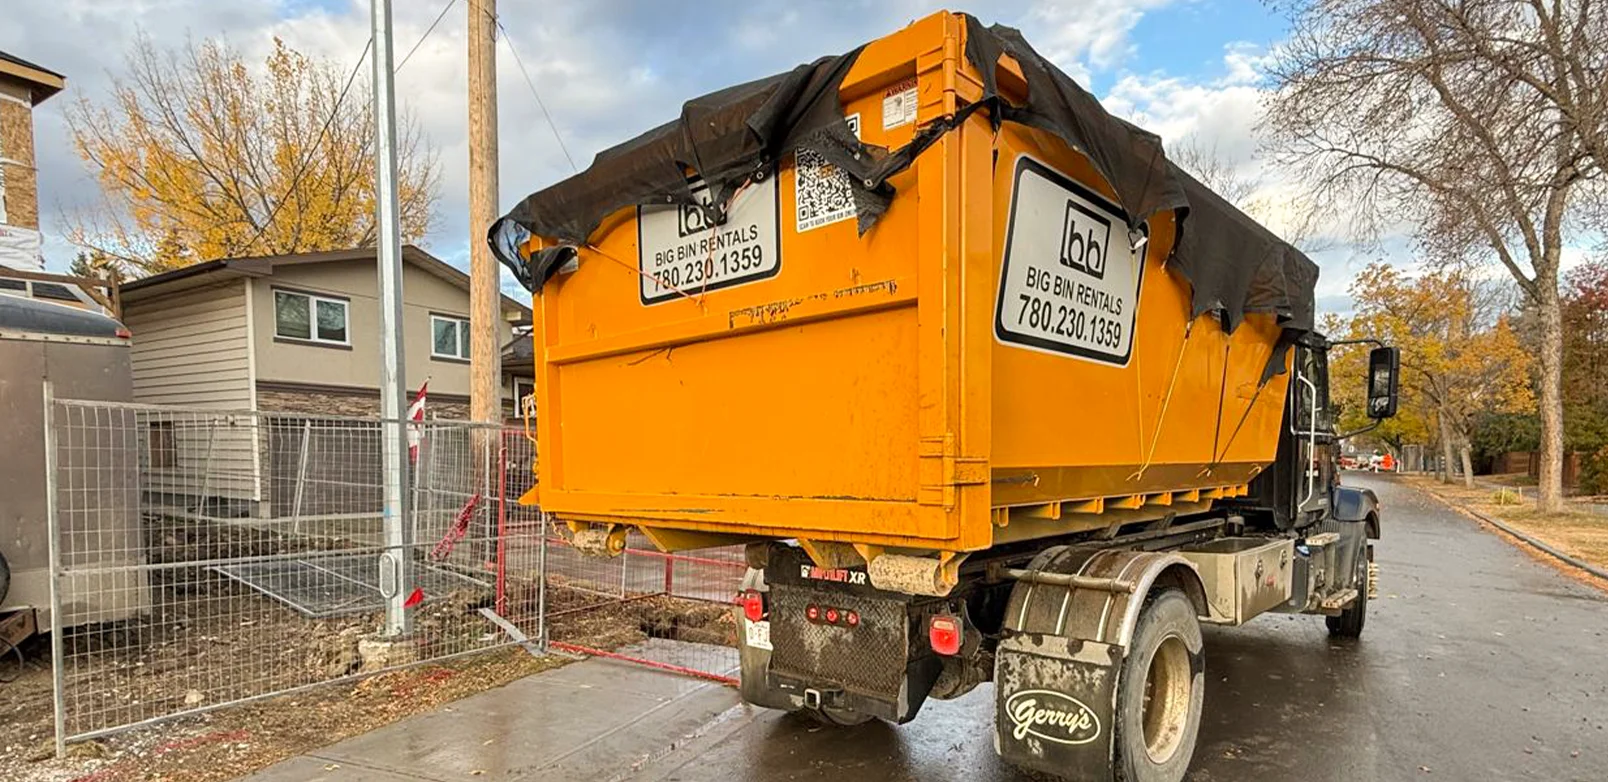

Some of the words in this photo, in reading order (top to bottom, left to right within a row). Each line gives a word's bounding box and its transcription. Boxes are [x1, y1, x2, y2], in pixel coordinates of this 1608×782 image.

[653, 244, 762, 291] 780.230.1359
[656, 249, 674, 267] BIG
[677, 242, 696, 261] BIN
[700, 224, 758, 254] RENTALS
[1026, 266, 1050, 292] BIG
[1053, 275, 1073, 301] BIN
[1077, 284, 1123, 316] RENTALS
[1018, 293, 1121, 348] 780.230.1359
[849, 570, 867, 585] XR
[1013, 698, 1092, 740] Gerry's
